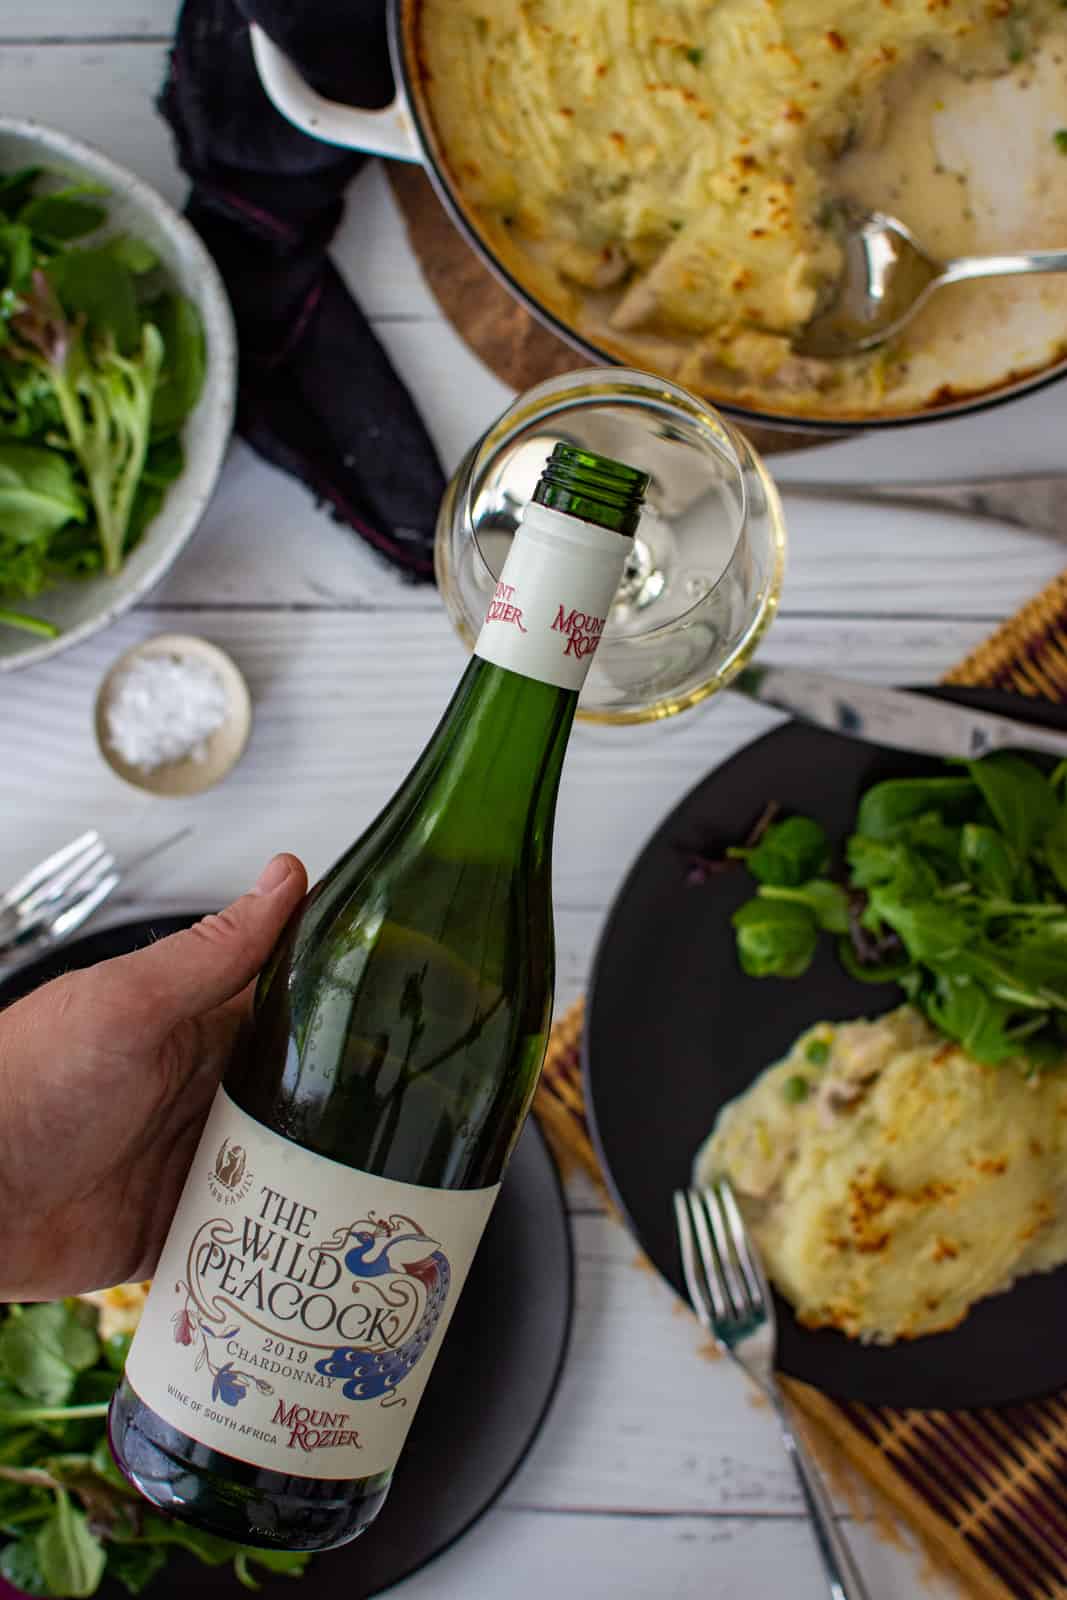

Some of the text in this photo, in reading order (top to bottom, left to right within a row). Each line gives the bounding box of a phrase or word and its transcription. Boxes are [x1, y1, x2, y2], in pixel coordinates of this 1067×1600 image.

[486, 600, 528, 632] OZIER
[260, 1186, 317, 1238] THE
[242, 1216, 342, 1290] WILD
[200, 1241, 395, 1349] PEACOCK
[226, 1340, 336, 1389] CHARDONNAY
[262, 1338, 308, 1364] 2019
[167, 1383, 277, 1445] WINE OF SOUTH AFRICA
[271, 1399, 349, 1428] MOUNT
[287, 1422, 363, 1452] ROZIER
